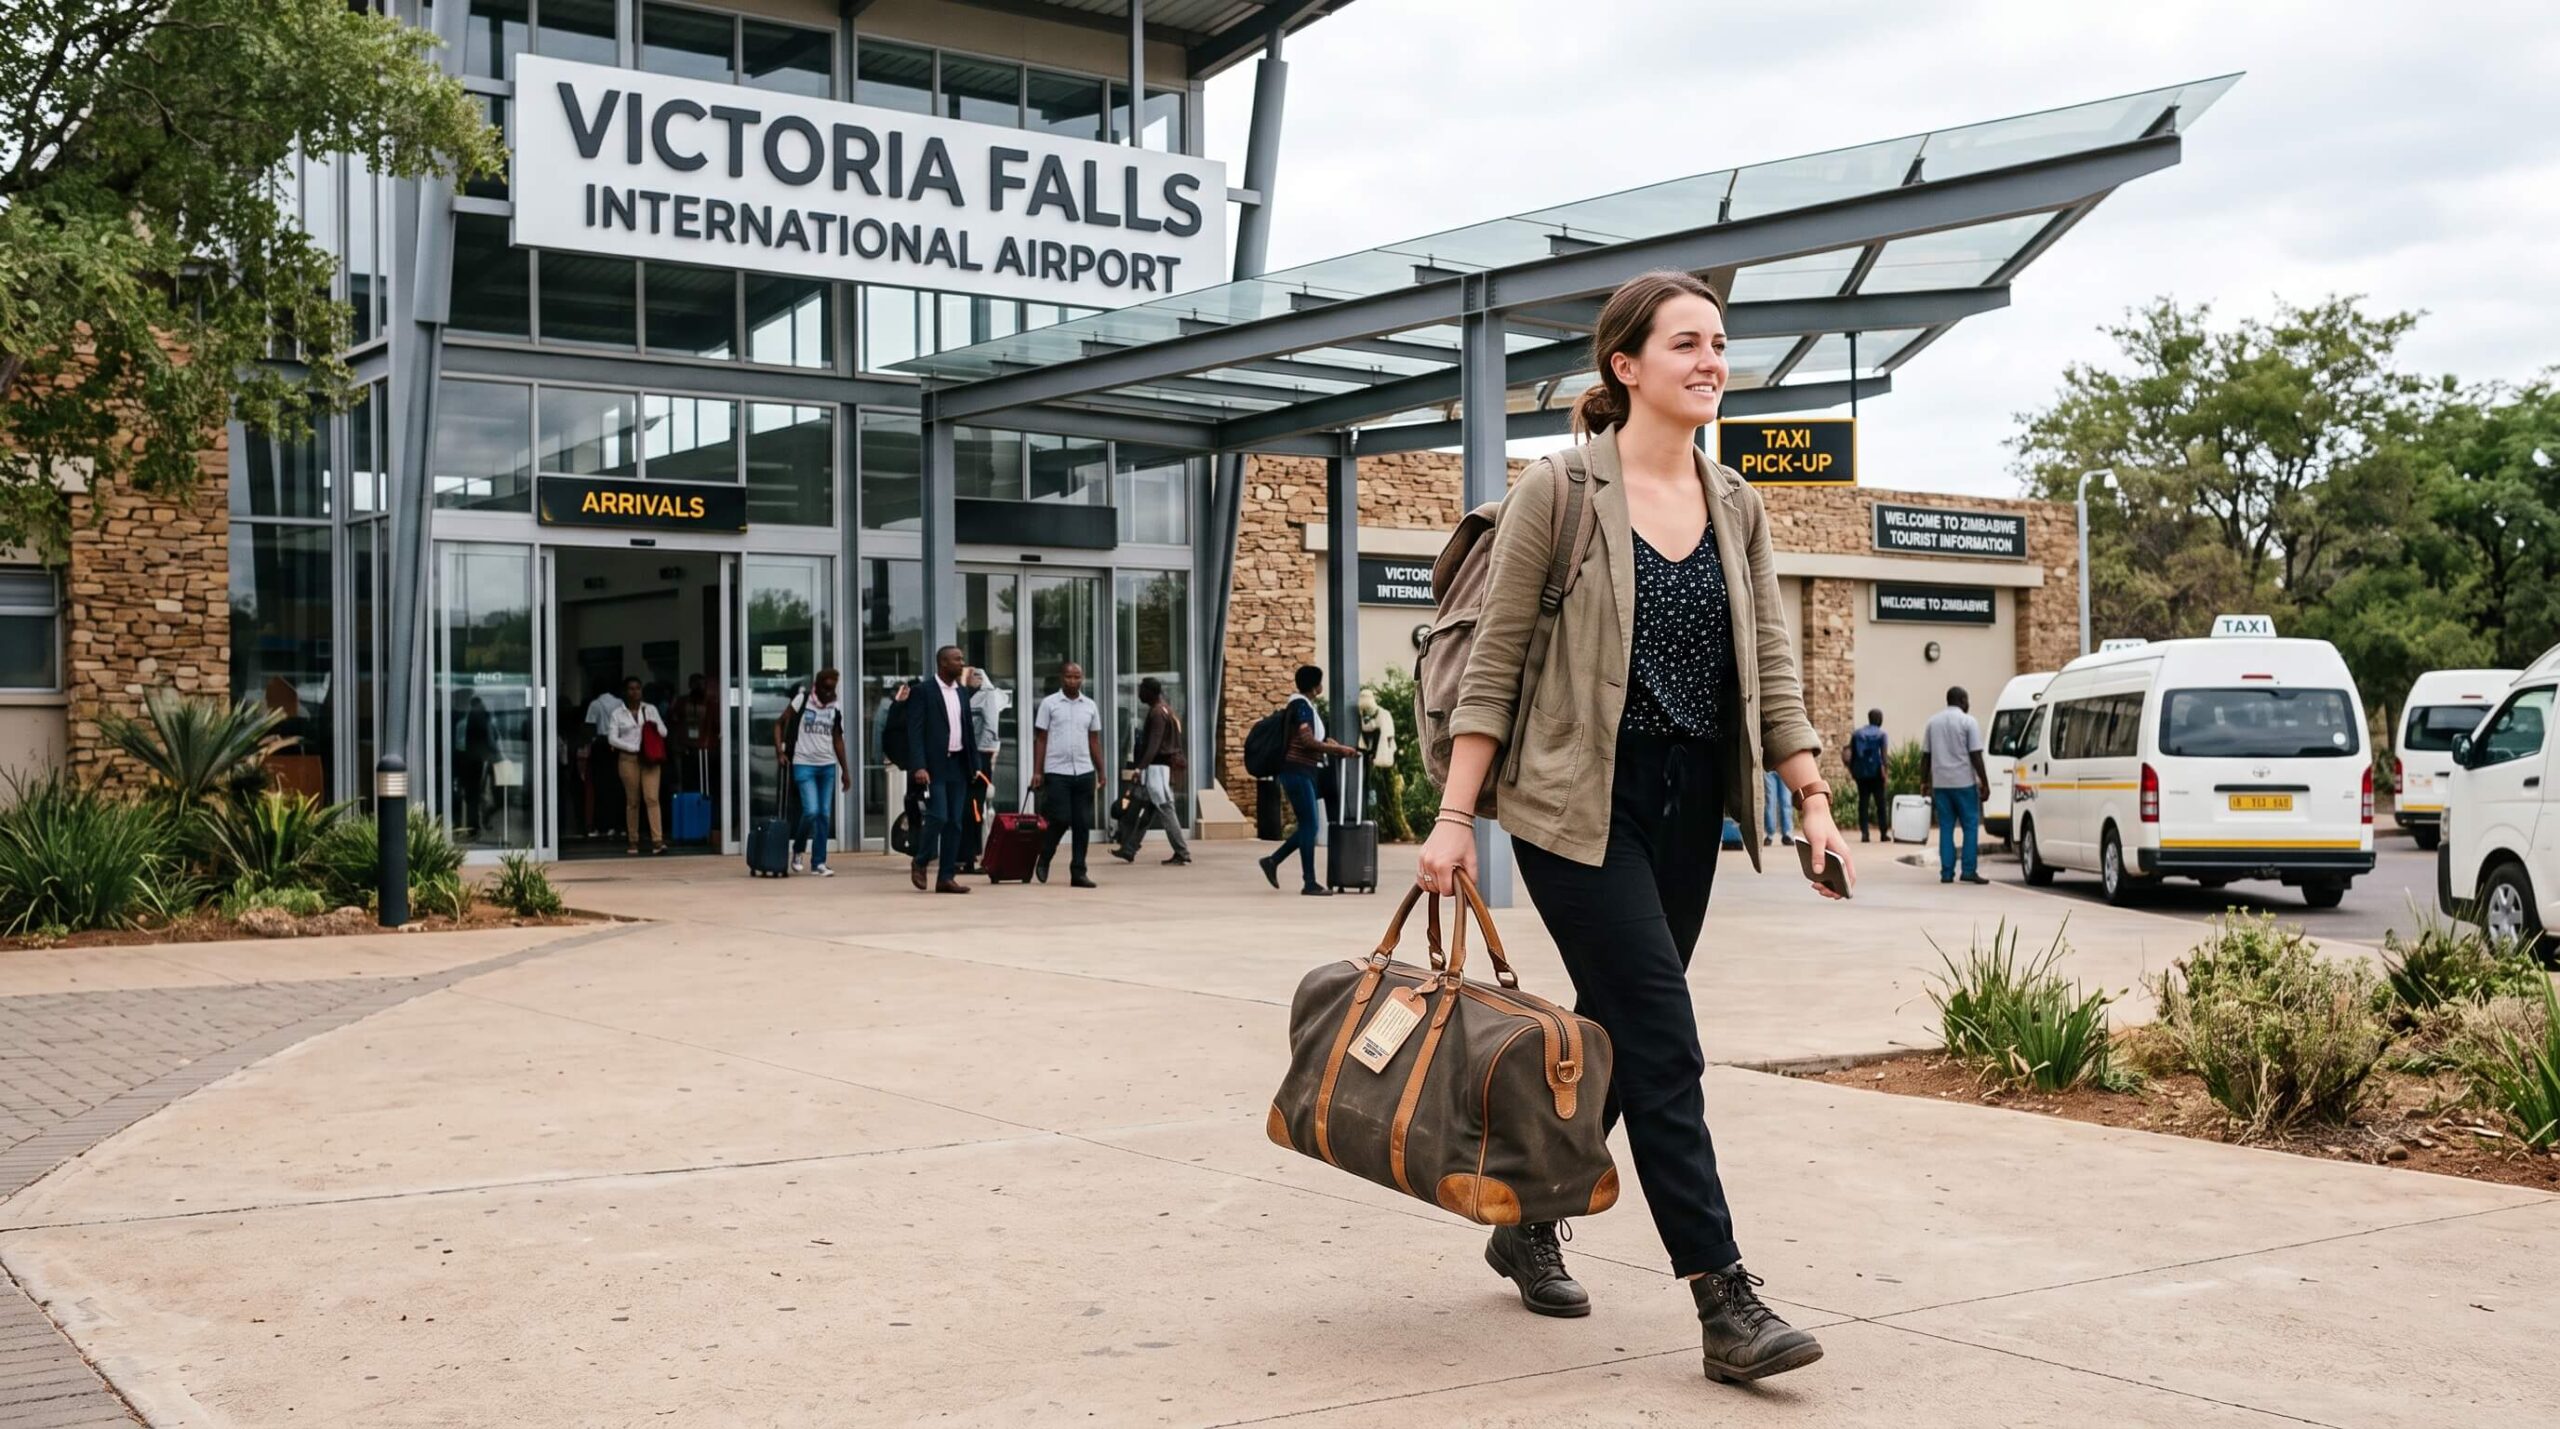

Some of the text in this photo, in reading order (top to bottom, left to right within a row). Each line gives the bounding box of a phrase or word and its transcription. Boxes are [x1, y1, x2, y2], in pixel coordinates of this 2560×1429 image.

[556, 82, 1203, 238] VICTORIA FALLS
[585, 184, 1182, 294] INTERNATIONAL AIRPORT
[1761, 429, 1811, 449] TAXI
[1741, 453, 1833, 474] PICK-UP
[581, 491, 705, 518] ARRIVALS
[1884, 511, 2017, 534] WELCOME TO ZIMBABWE
[1890, 530, 2013, 552] TOURIST INFORMATION
[1880, 596, 1990, 612] WELCOME TO ZIMBABWE
[2223, 620, 2267, 633] TAXI
